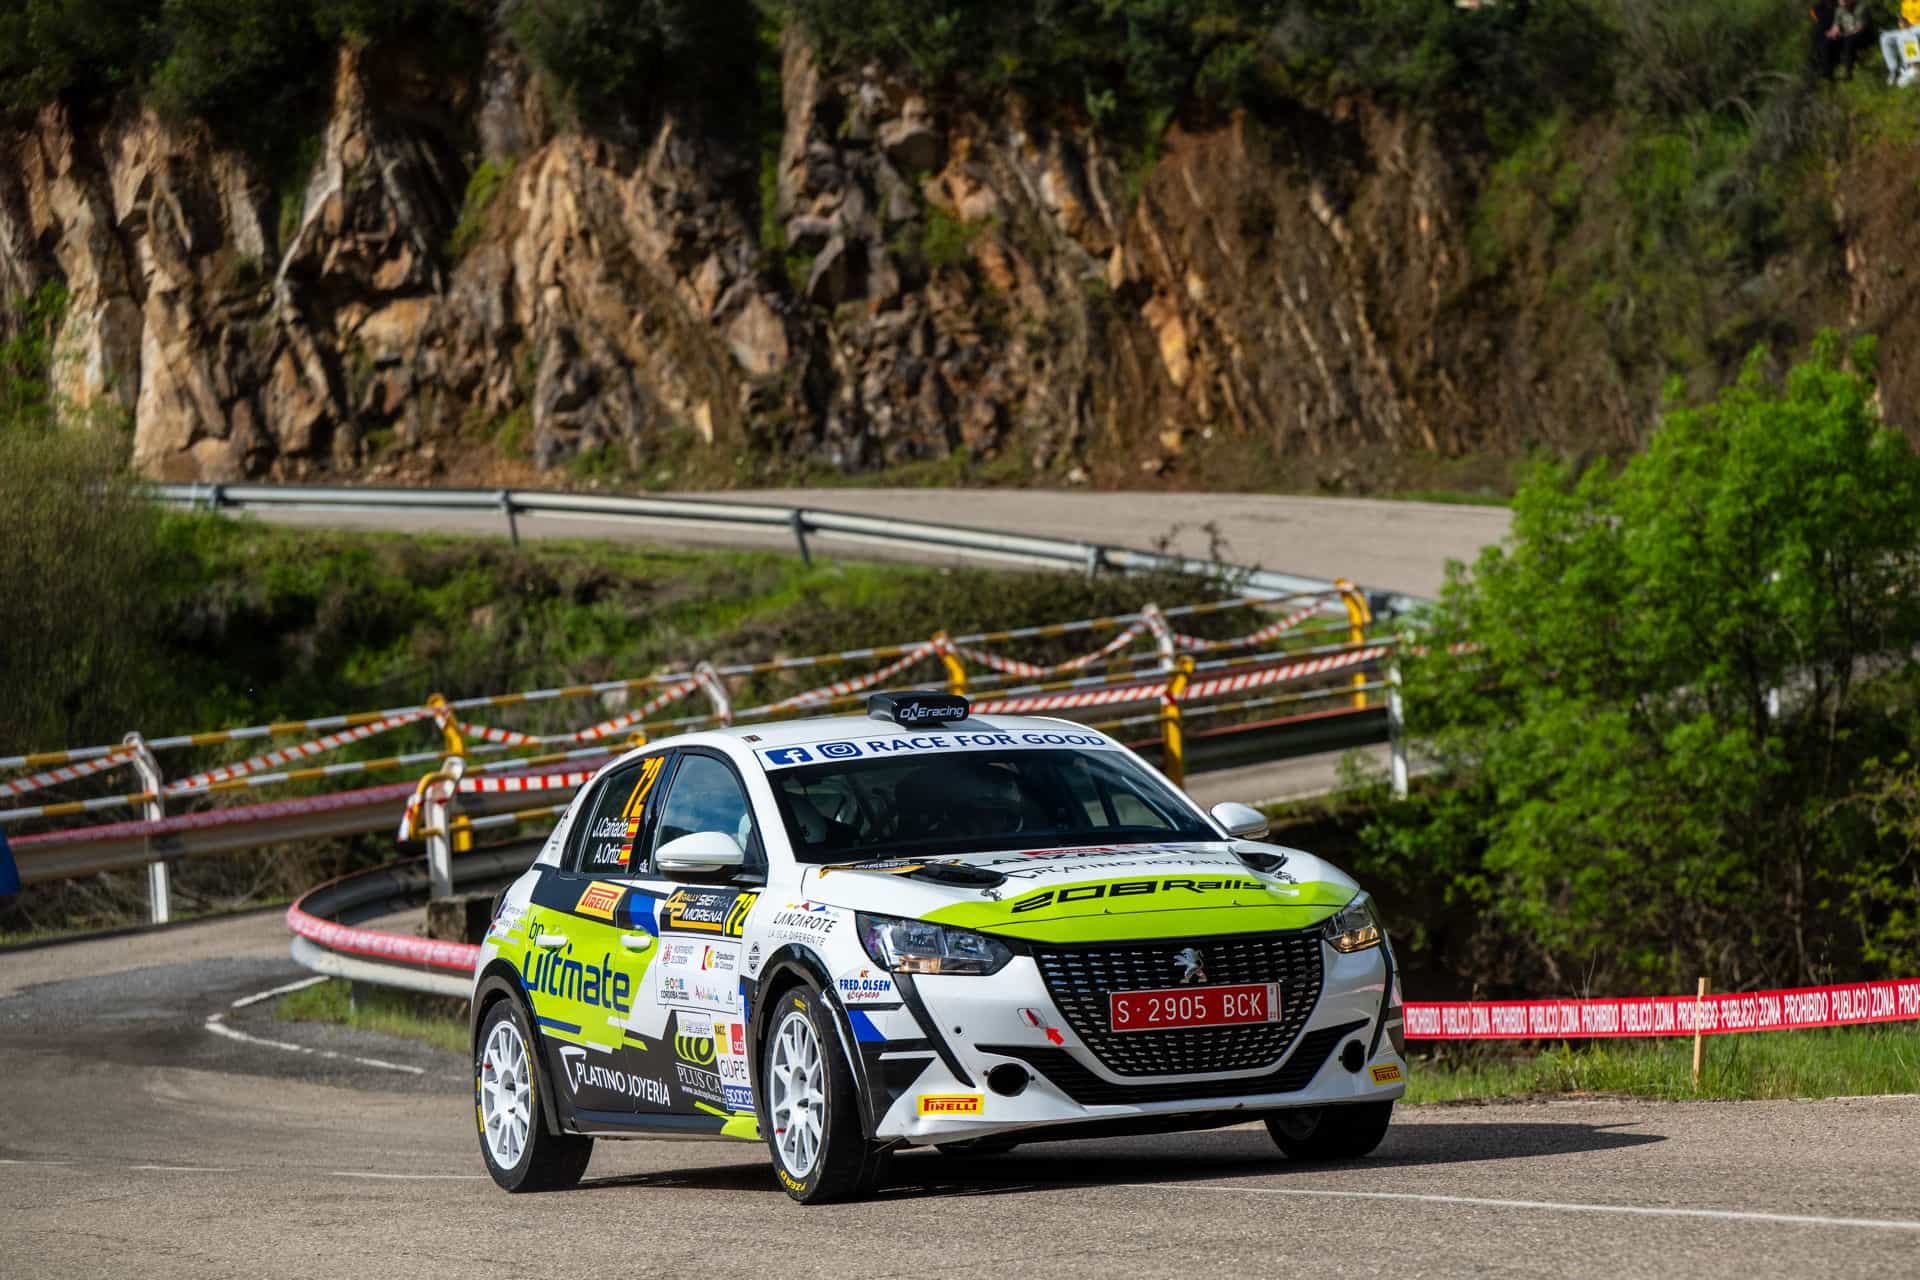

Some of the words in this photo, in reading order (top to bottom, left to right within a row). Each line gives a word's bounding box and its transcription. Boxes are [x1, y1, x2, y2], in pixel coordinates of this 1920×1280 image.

[866, 734, 951, 753] RACE
[957, 732, 1015, 748] FOR
[1021, 732, 1106, 746] GOOD
[621, 756, 665, 818] 72
[580, 886, 620, 913] PIRELLI
[682, 907, 723, 923] MORENA
[726, 892, 757, 936] 72
[773, 911, 837, 933] LANZAROTE
[1117, 1000, 1130, 1023] S
[1148, 995, 1207, 1022] 2905
[1223, 992, 1263, 1018] BCK
[1582, 1004, 1619, 1032] PROHIBIDO
[1621, 1003, 1652, 1031] PUBLICO
[1654, 1002, 1675, 1032] ZONA
[1720, 998, 1755, 1028] PUBLICO
[1758, 995, 1781, 1026] ZONA
[1784, 991, 1829, 1024] PROHIBIDO
[1831, 988, 1869, 1020] PUBLICO
[1871, 985, 1895, 1017] ZONA
[576, 1062, 626, 1094] PLATINO
[628, 1073, 672, 1107] JOYERÍA
[677, 1066, 706, 1089] PLUS
[706, 1074, 726, 1096] CA
[1373, 1065, 1401, 1081] PIRELLI
[924, 1097, 978, 1111] PIRELLI
